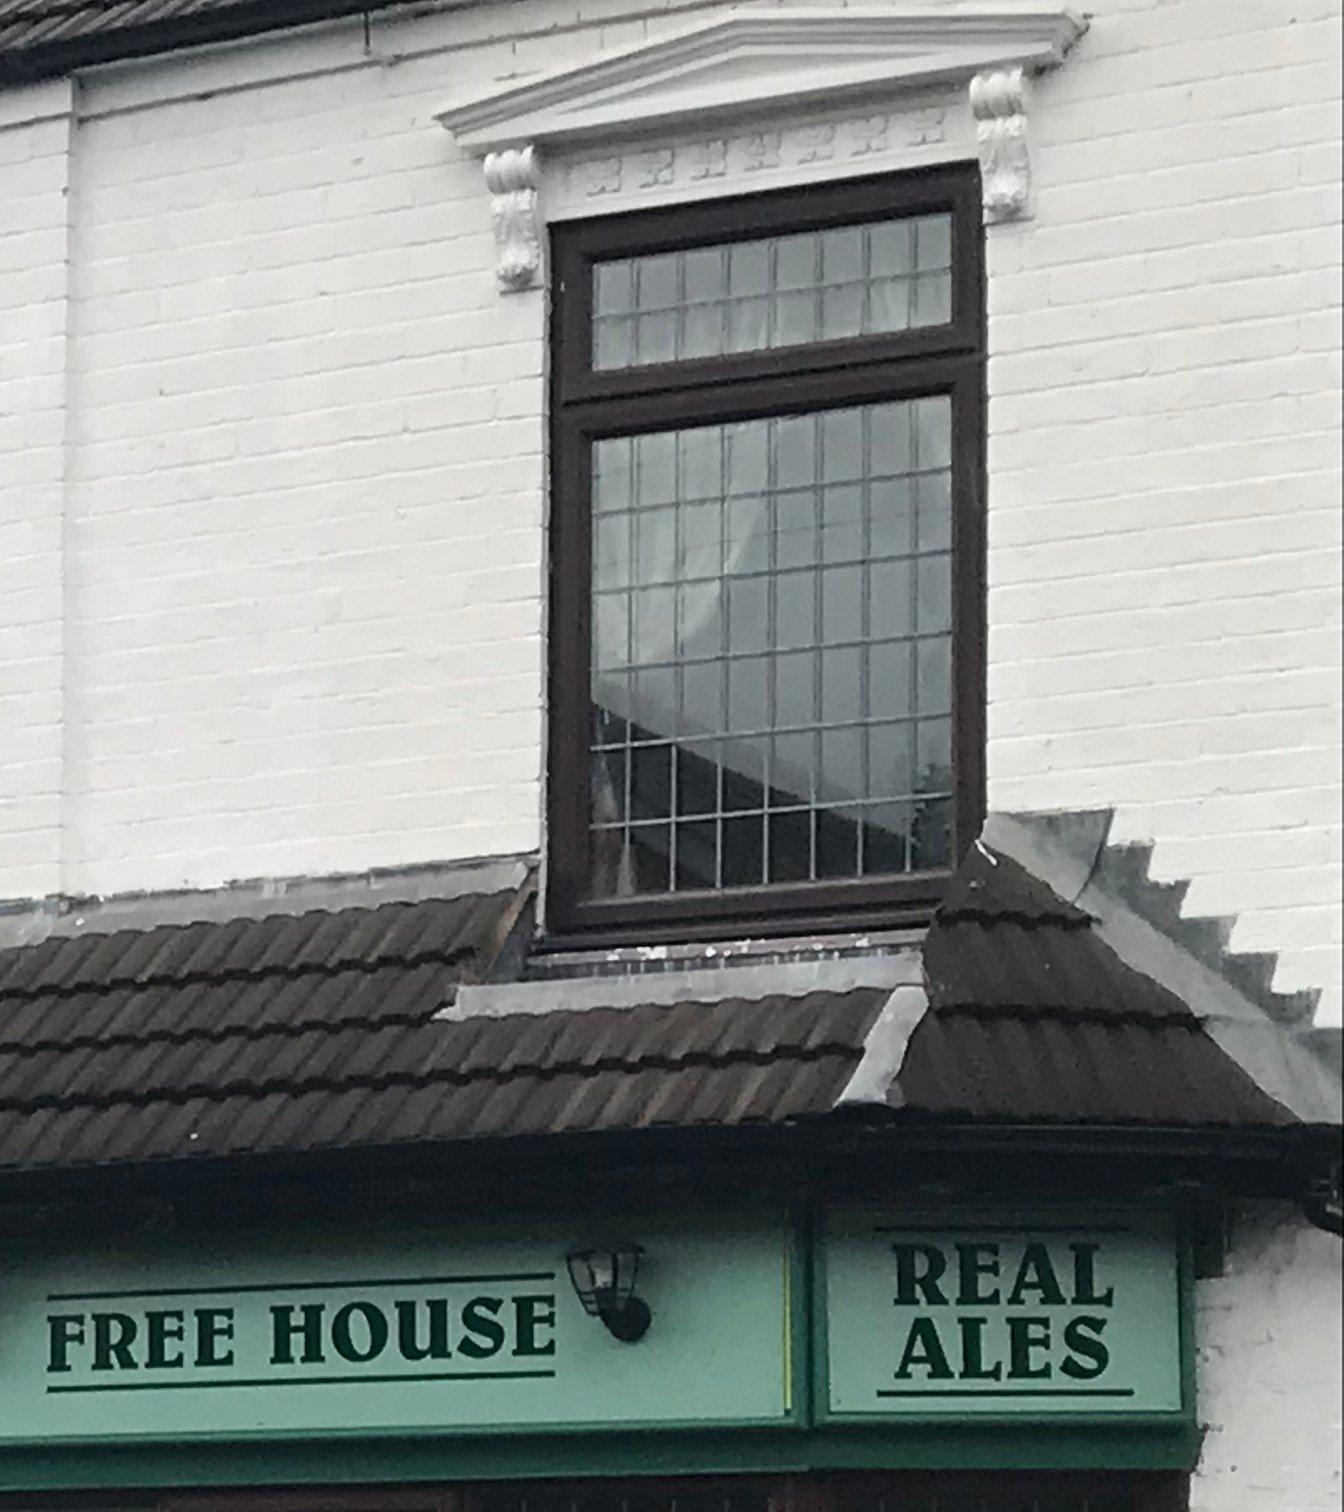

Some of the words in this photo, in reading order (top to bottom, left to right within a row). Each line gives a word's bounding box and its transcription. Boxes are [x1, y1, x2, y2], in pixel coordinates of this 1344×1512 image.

[892, 1241, 1114, 1308] REAL
[45, 1307, 235, 1373] FREE
[269, 1294, 557, 1365] HOUSE
[893, 1315, 1110, 1382] ALES
